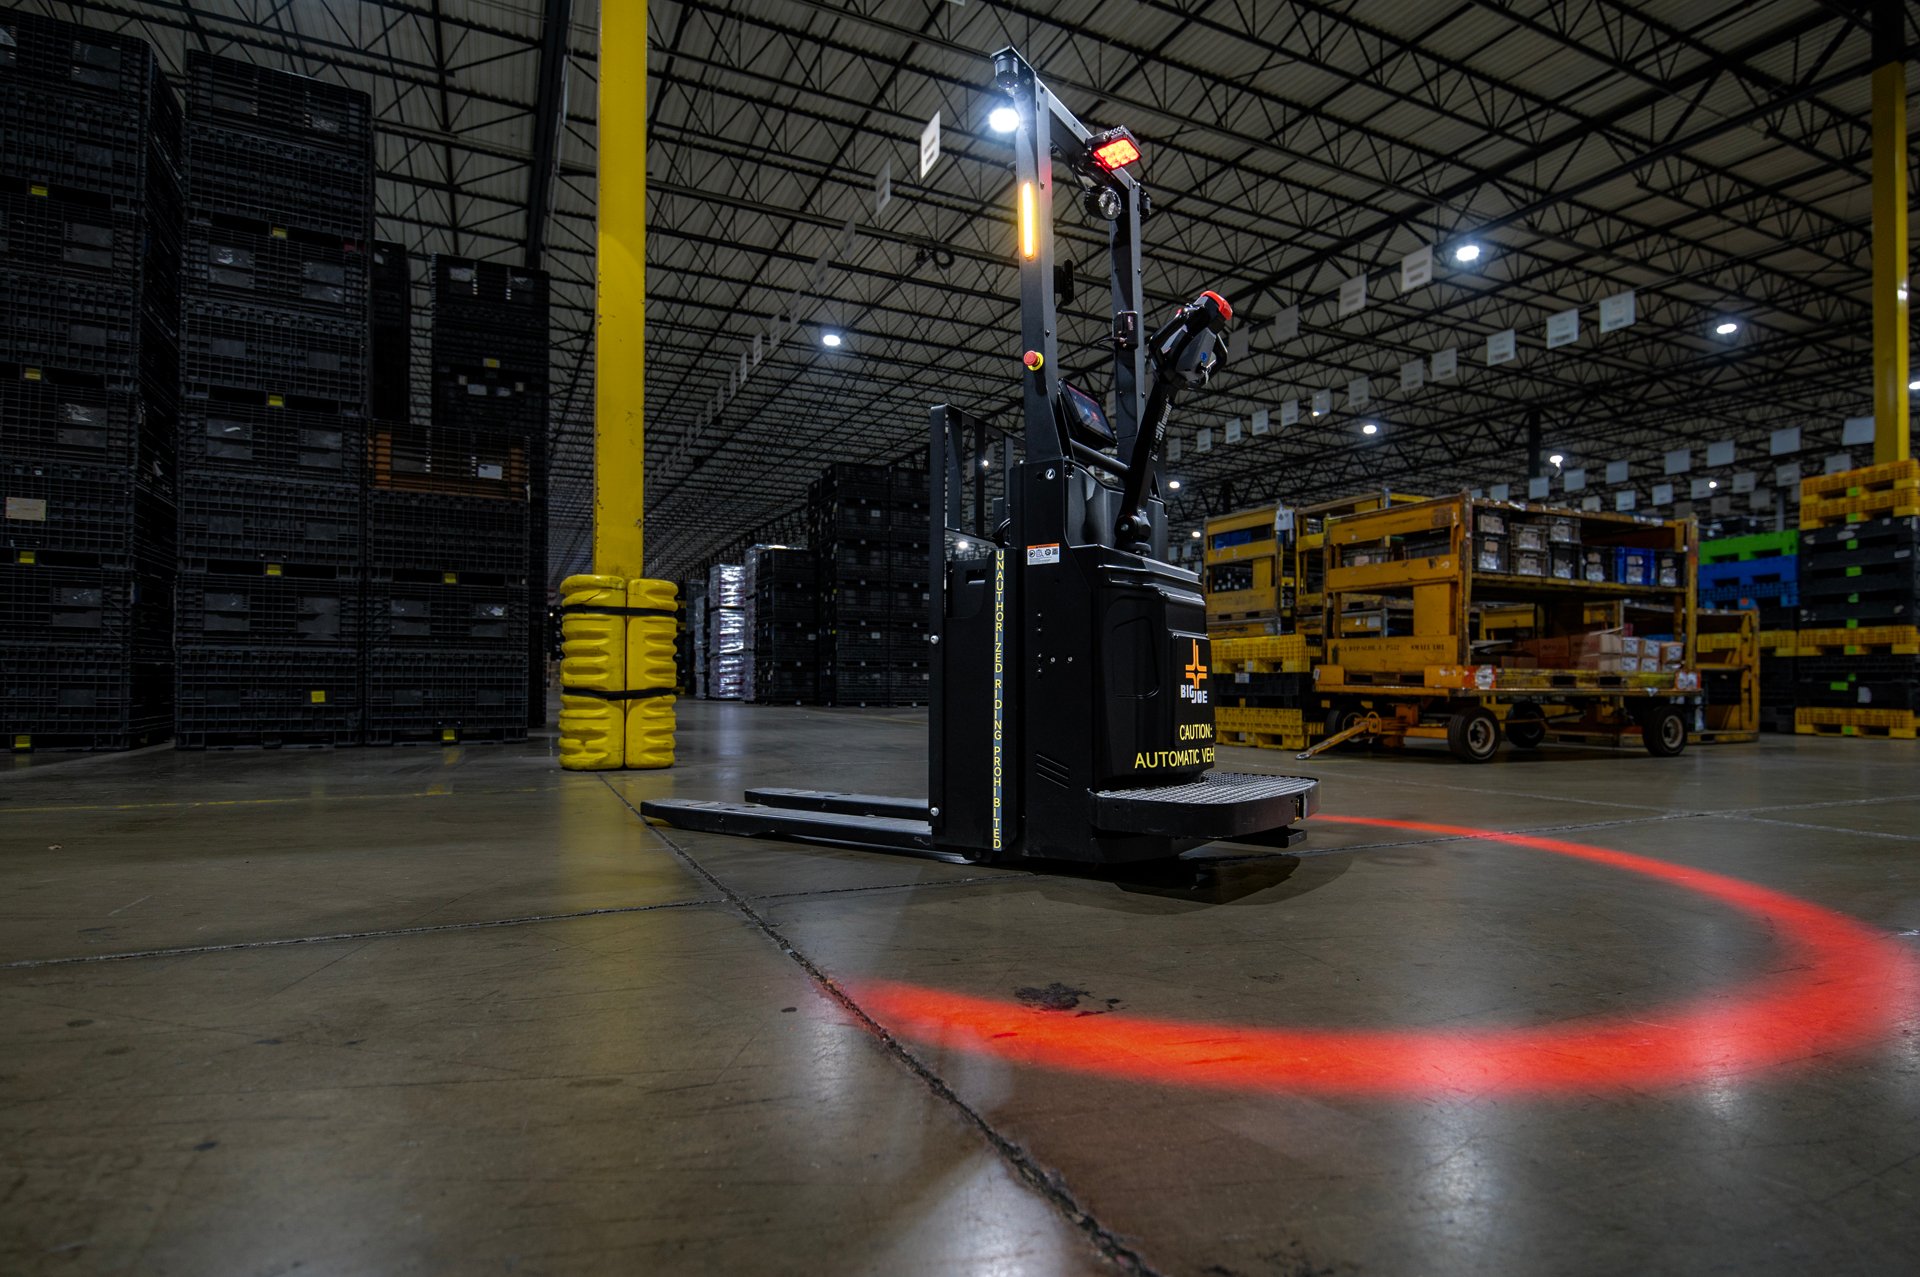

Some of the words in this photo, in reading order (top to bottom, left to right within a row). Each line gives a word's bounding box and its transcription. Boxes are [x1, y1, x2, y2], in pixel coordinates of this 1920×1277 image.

[995, 550, 1004, 673] UNAUTHORIZED
[1180, 684, 1195, 698] BIG
[1191, 690, 1207, 704] JOE
[994, 679, 1003, 741] RIDING
[1180, 723, 1213, 740] CAUTION:
[1134, 748, 1200, 769] AUTOMATIC
[993, 746, 1002, 849] PROHIBITED
